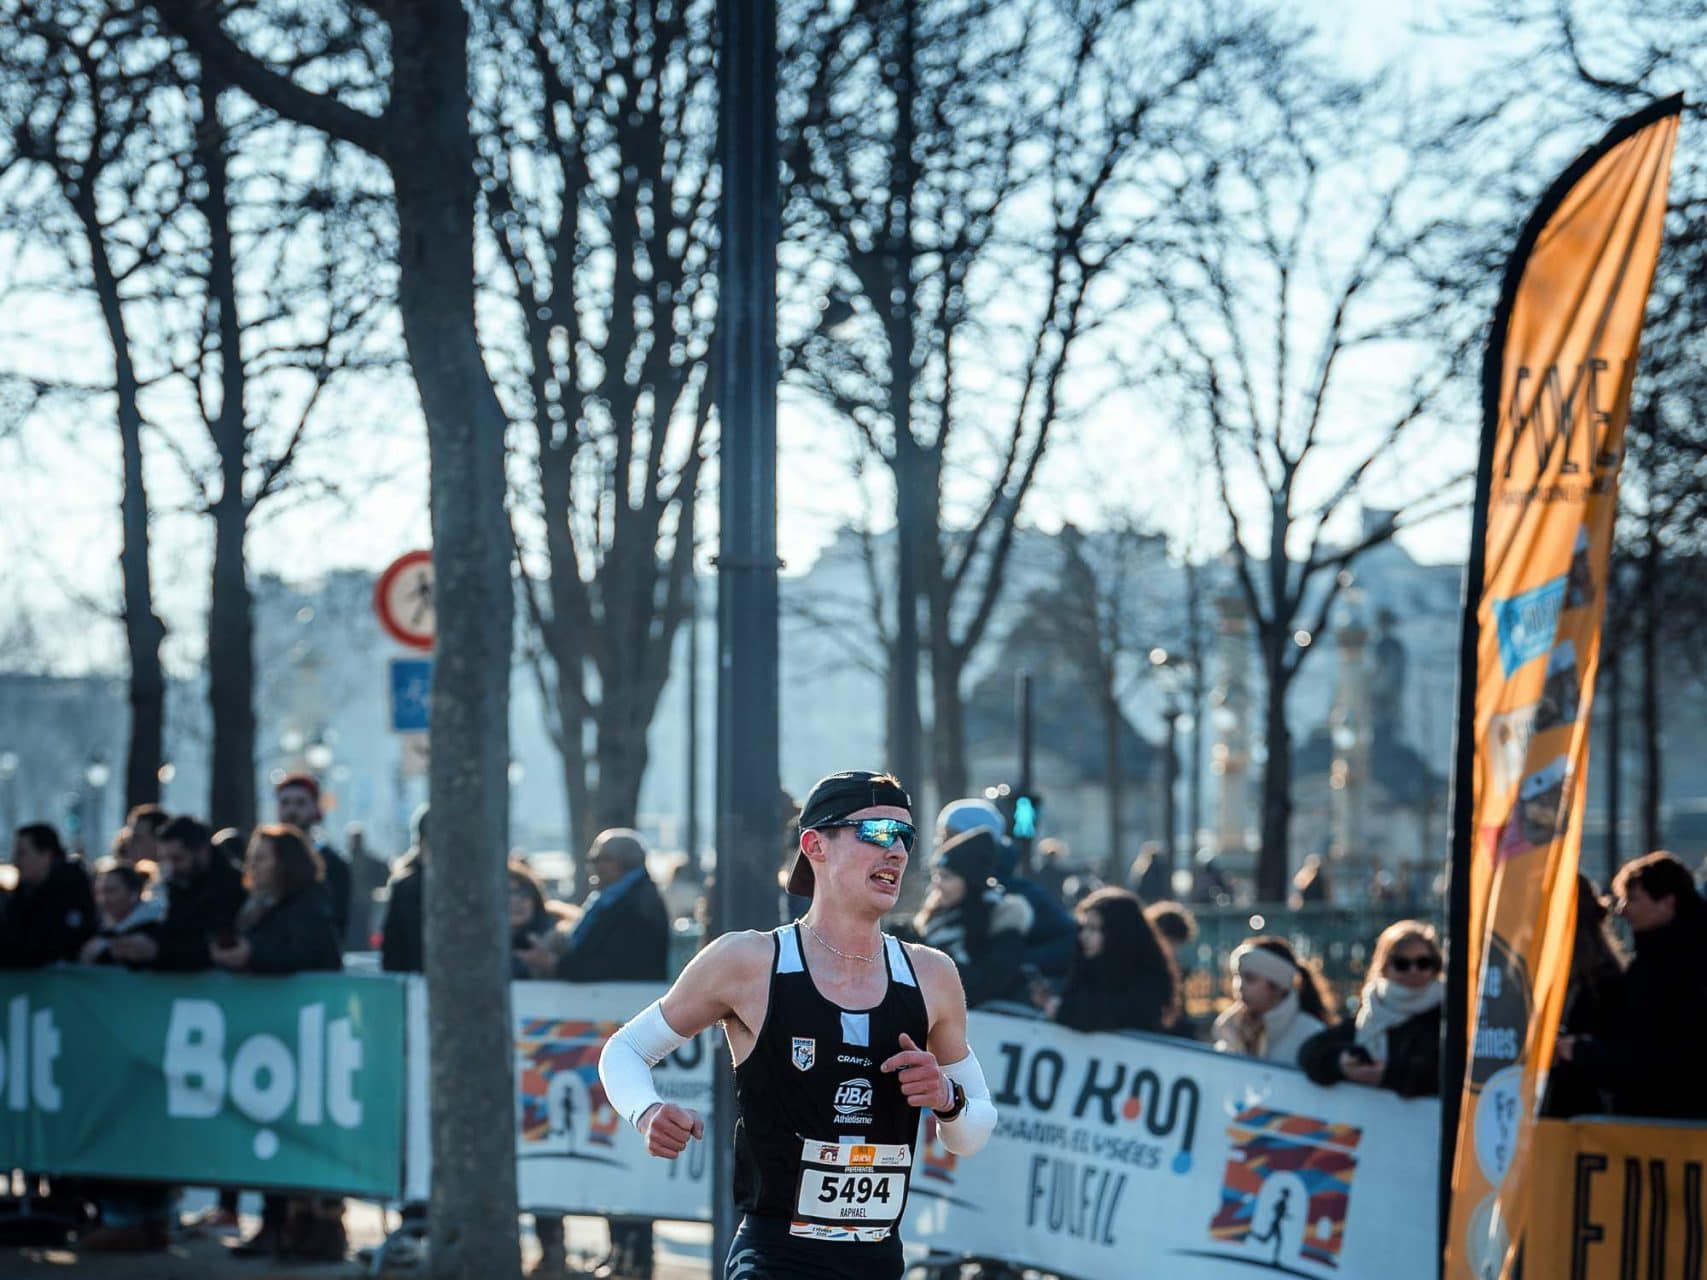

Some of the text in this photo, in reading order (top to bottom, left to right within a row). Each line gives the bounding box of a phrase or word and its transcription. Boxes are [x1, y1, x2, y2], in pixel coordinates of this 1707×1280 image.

[0, 994, 61, 1112] lt
[163, 998, 363, 1130] Bolt
[834, 1086, 873, 1106] HBA
[995, 1043, 1200, 1174] 10 KM
[818, 1176, 890, 1204] 5494
[840, 1207, 867, 1218] RAPHAEL
